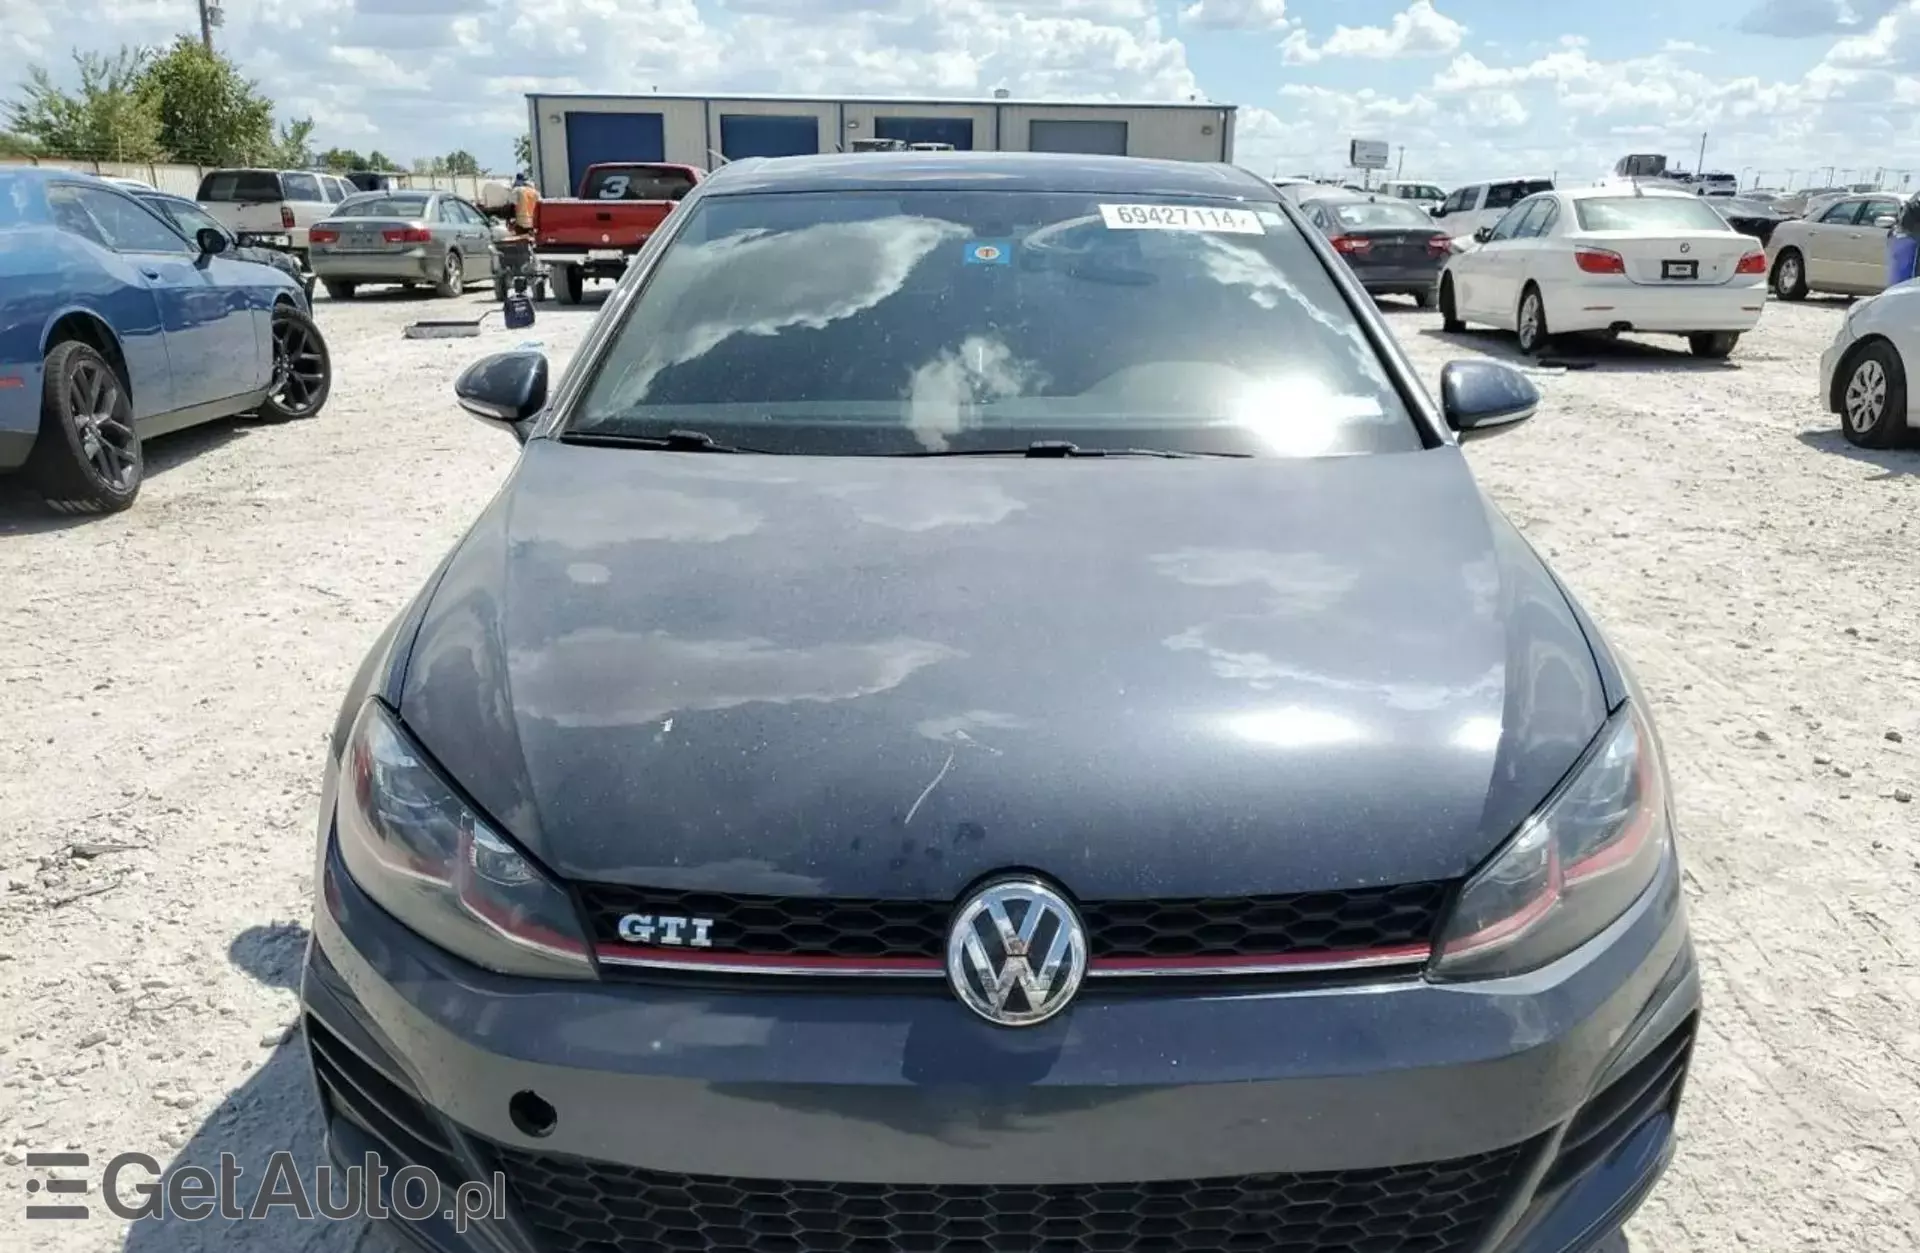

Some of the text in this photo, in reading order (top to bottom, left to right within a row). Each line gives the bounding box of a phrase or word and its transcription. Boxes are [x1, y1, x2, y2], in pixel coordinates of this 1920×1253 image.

[599, 175, 630, 199] 3
[618, 913, 714, 947] GTI
[950, 884, 1084, 1023] VW
